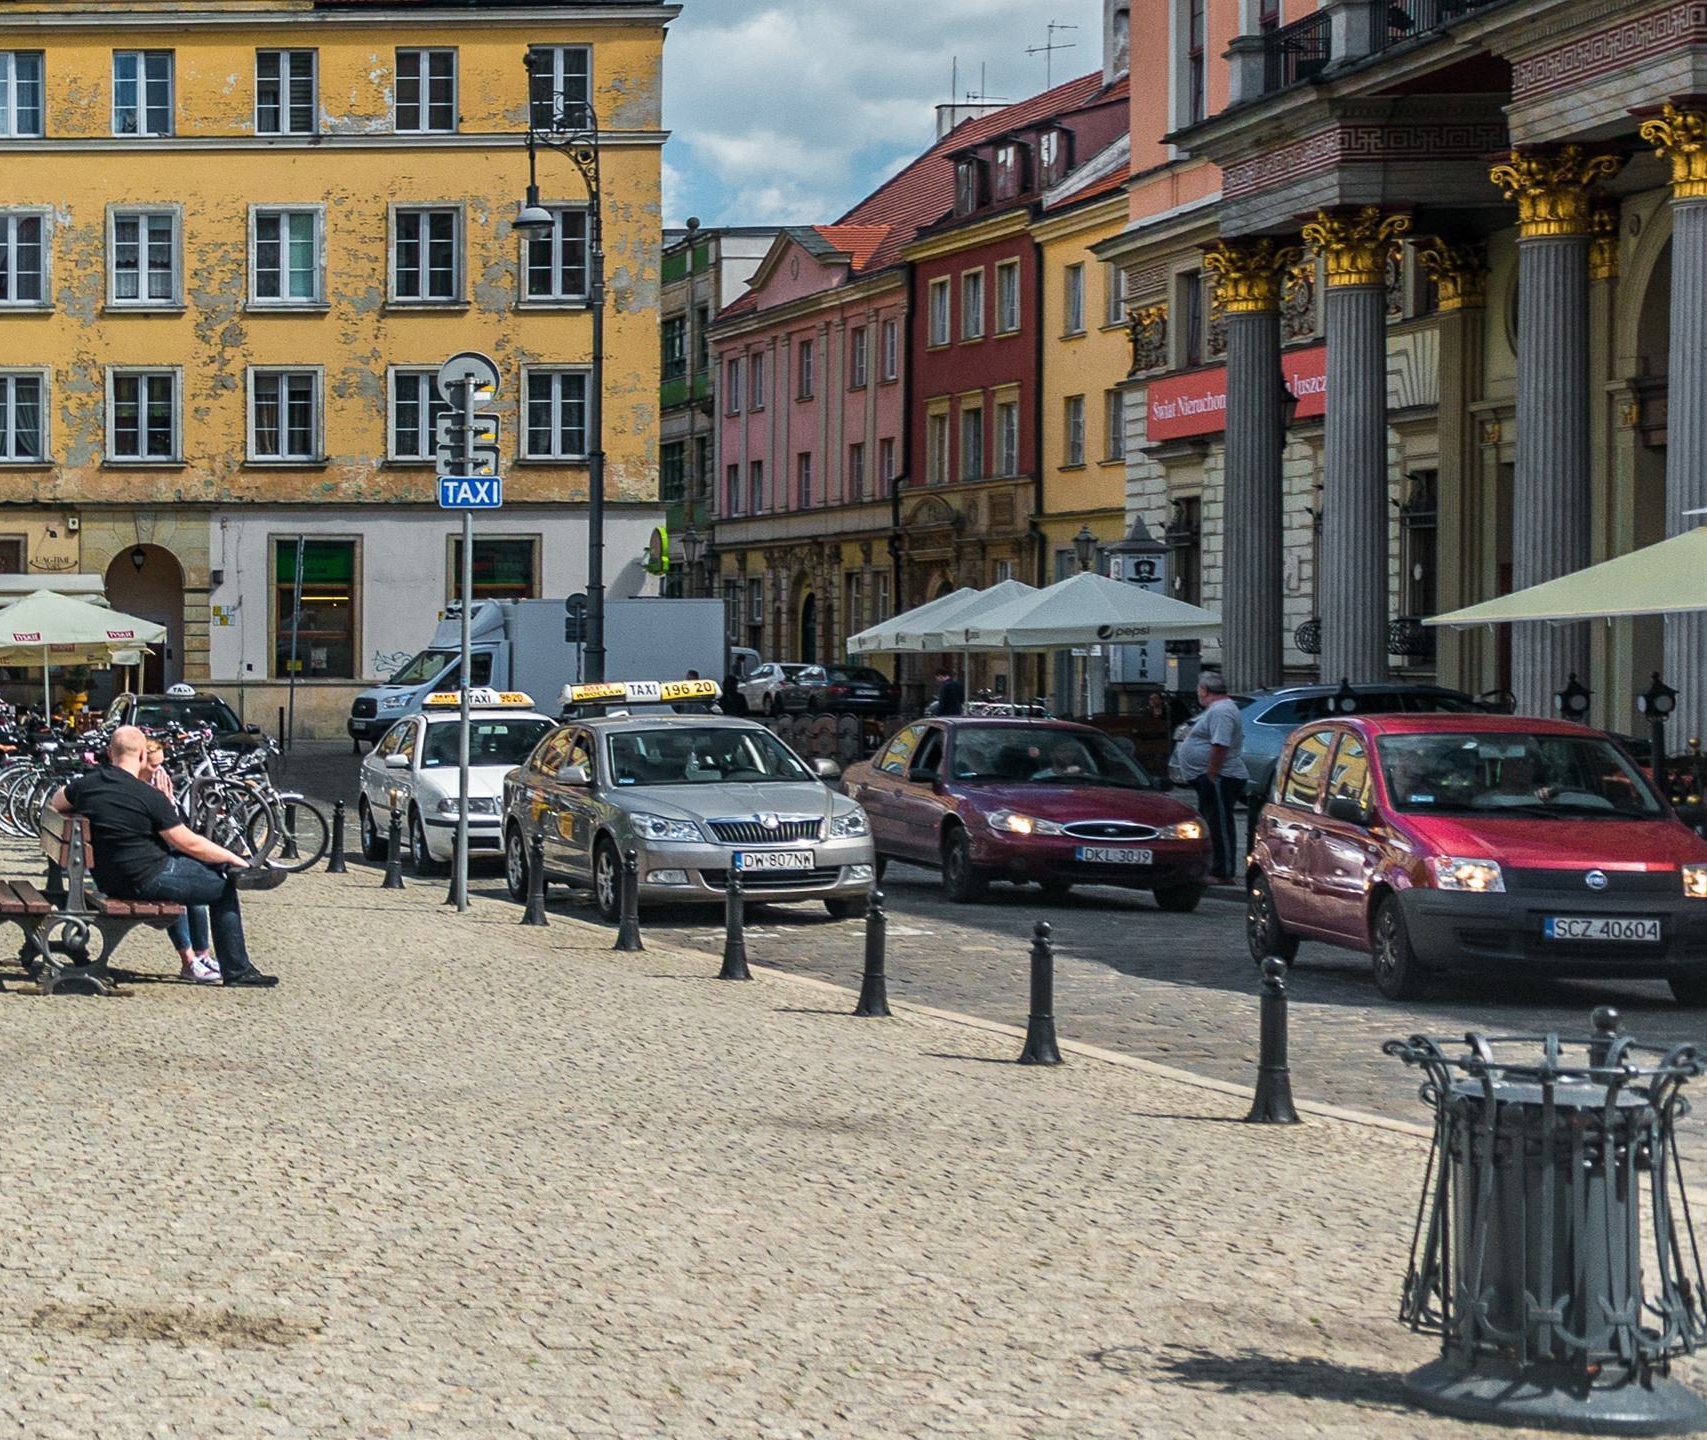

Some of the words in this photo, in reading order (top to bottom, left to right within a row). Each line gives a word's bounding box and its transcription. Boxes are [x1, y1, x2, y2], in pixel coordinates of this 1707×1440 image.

[443, 481, 498, 503] TAXI
[1115, 626, 1150, 637] pepsi
[629, 684, 657, 696] TAXI
[665, 684, 690, 696] 196
[695, 681, 712, 693] 20
[467, 694, 491, 703] TAXI
[744, 854, 764, 867] DW
[1086, 848, 1113, 862] DKL
[1555, 920, 1593, 938] SCZ
[1600, 921, 1658, 939] 40604
